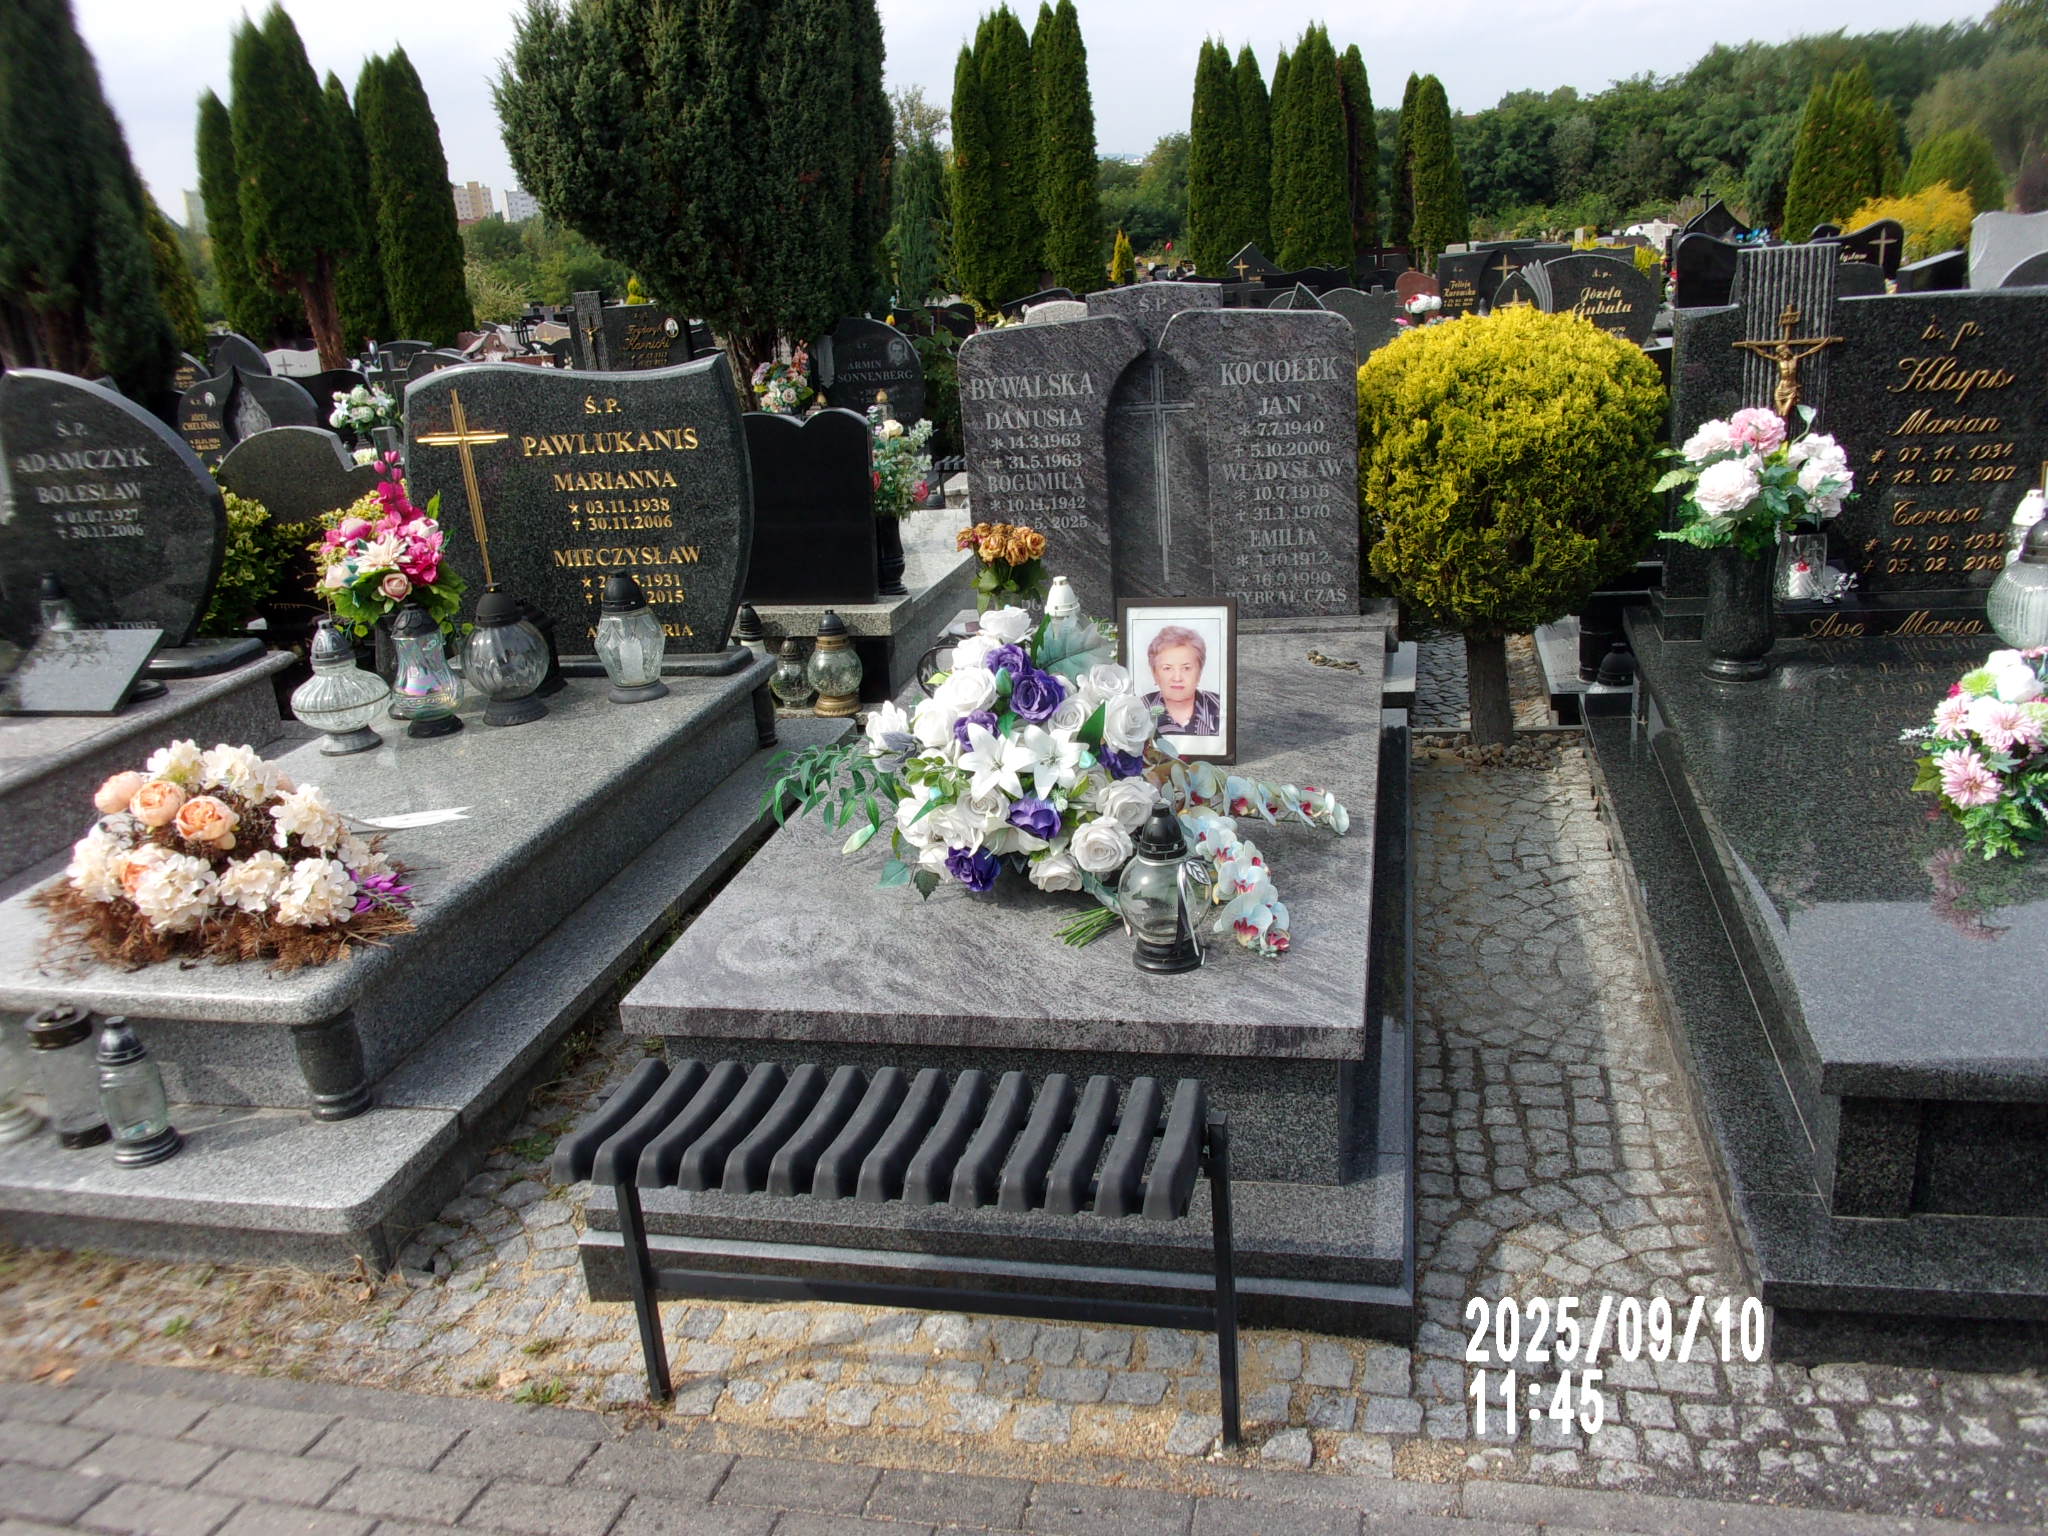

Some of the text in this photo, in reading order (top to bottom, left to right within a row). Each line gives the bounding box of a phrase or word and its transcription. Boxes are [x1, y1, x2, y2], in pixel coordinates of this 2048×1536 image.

[848, 359, 882, 370] ARMIN
[1220, 356, 1339, 386] KOCIOŁEK
[837, 369, 913, 383] SONNENBERG
[970, 371, 1095, 401] BYWALSKA
[1886, 357, 2018, 403] Klups
[584, 395, 622, 414] Ś. P.
[1258, 394, 1303, 416] JAN
[985, 409, 1083, 430] DANUSIA
[1257, 419, 1324, 437] 7.7.1940
[1886, 408, 2001, 437] Marian
[521, 427, 700, 457] PAWLUKANIS
[1009, 433, 1081, 449] 14.3.1963
[1250, 440, 1330, 458] 5.10.2000
[15, 448, 152, 473] ADAMCZYK
[1008, 453, 1082, 470] 31.5.1963
[554, 469, 678, 492] MARIANNA
[586, 498, 671, 515] 03.11.1938
[1891, 500, 1984, 527] Teresa
[587, 514, 673, 531] 30.11.2006
[1249, 527, 1318, 547] EMILIA
[554, 546, 700, 567] MIECZYSŁAW
[1802, 609, 1985, 641] Ave Maria
